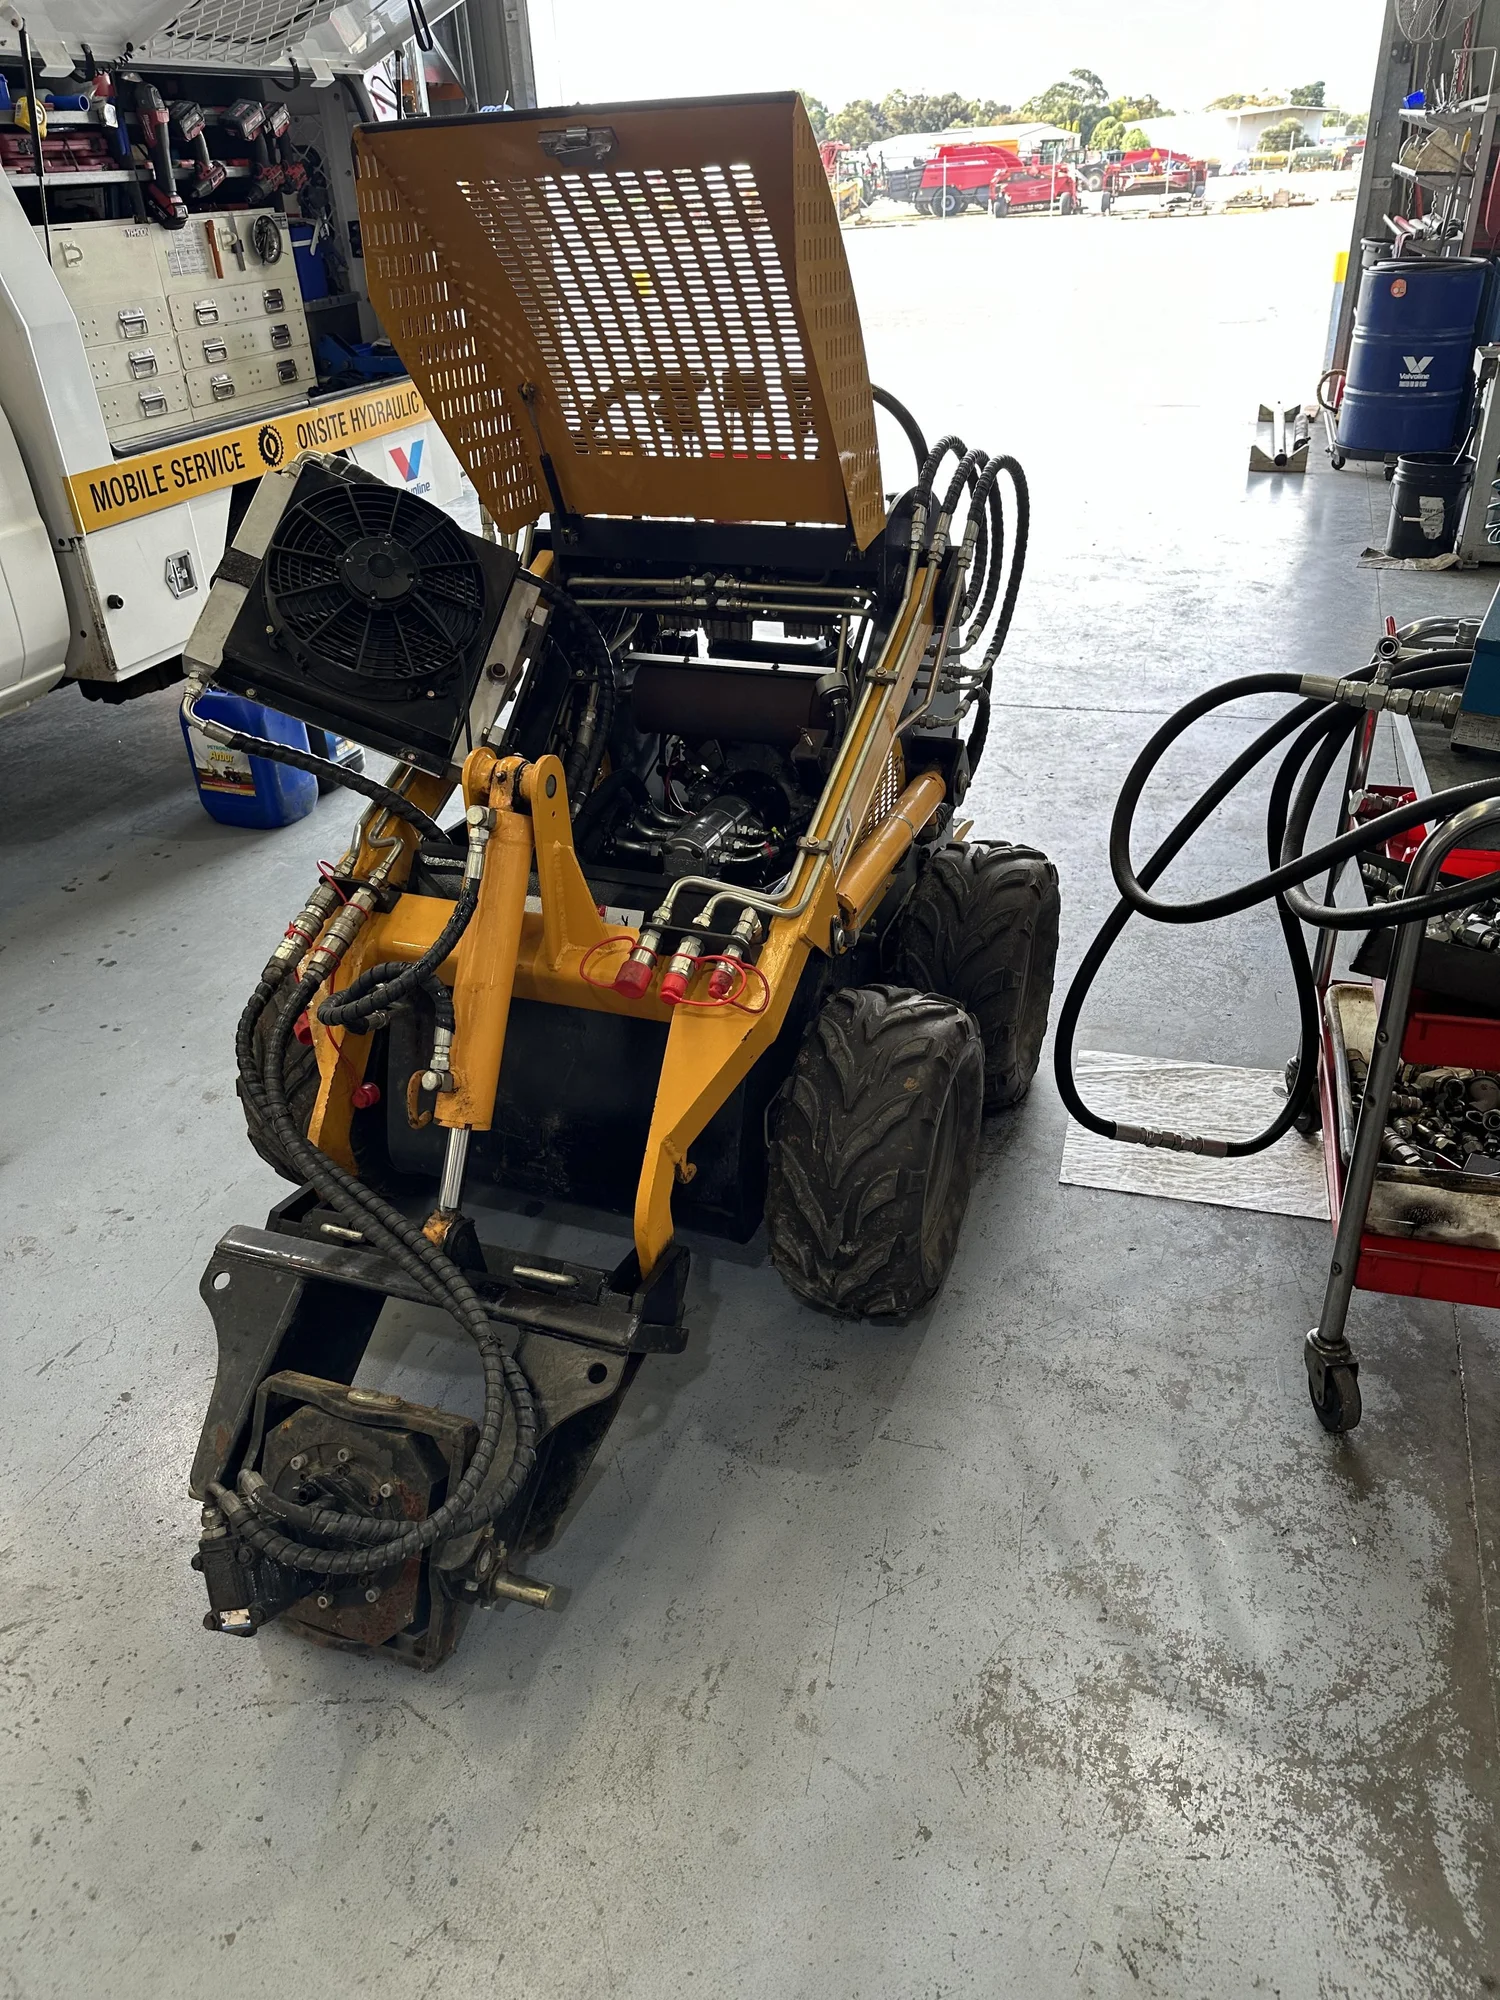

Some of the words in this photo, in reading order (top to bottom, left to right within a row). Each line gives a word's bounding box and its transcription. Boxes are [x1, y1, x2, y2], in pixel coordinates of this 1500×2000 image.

[89, 463, 169, 513] MOBILE
[173, 441, 246, 488] SERVICE
[296, 411, 348, 449] ONSITE
[350, 391, 419, 433] HYDRAULIC
